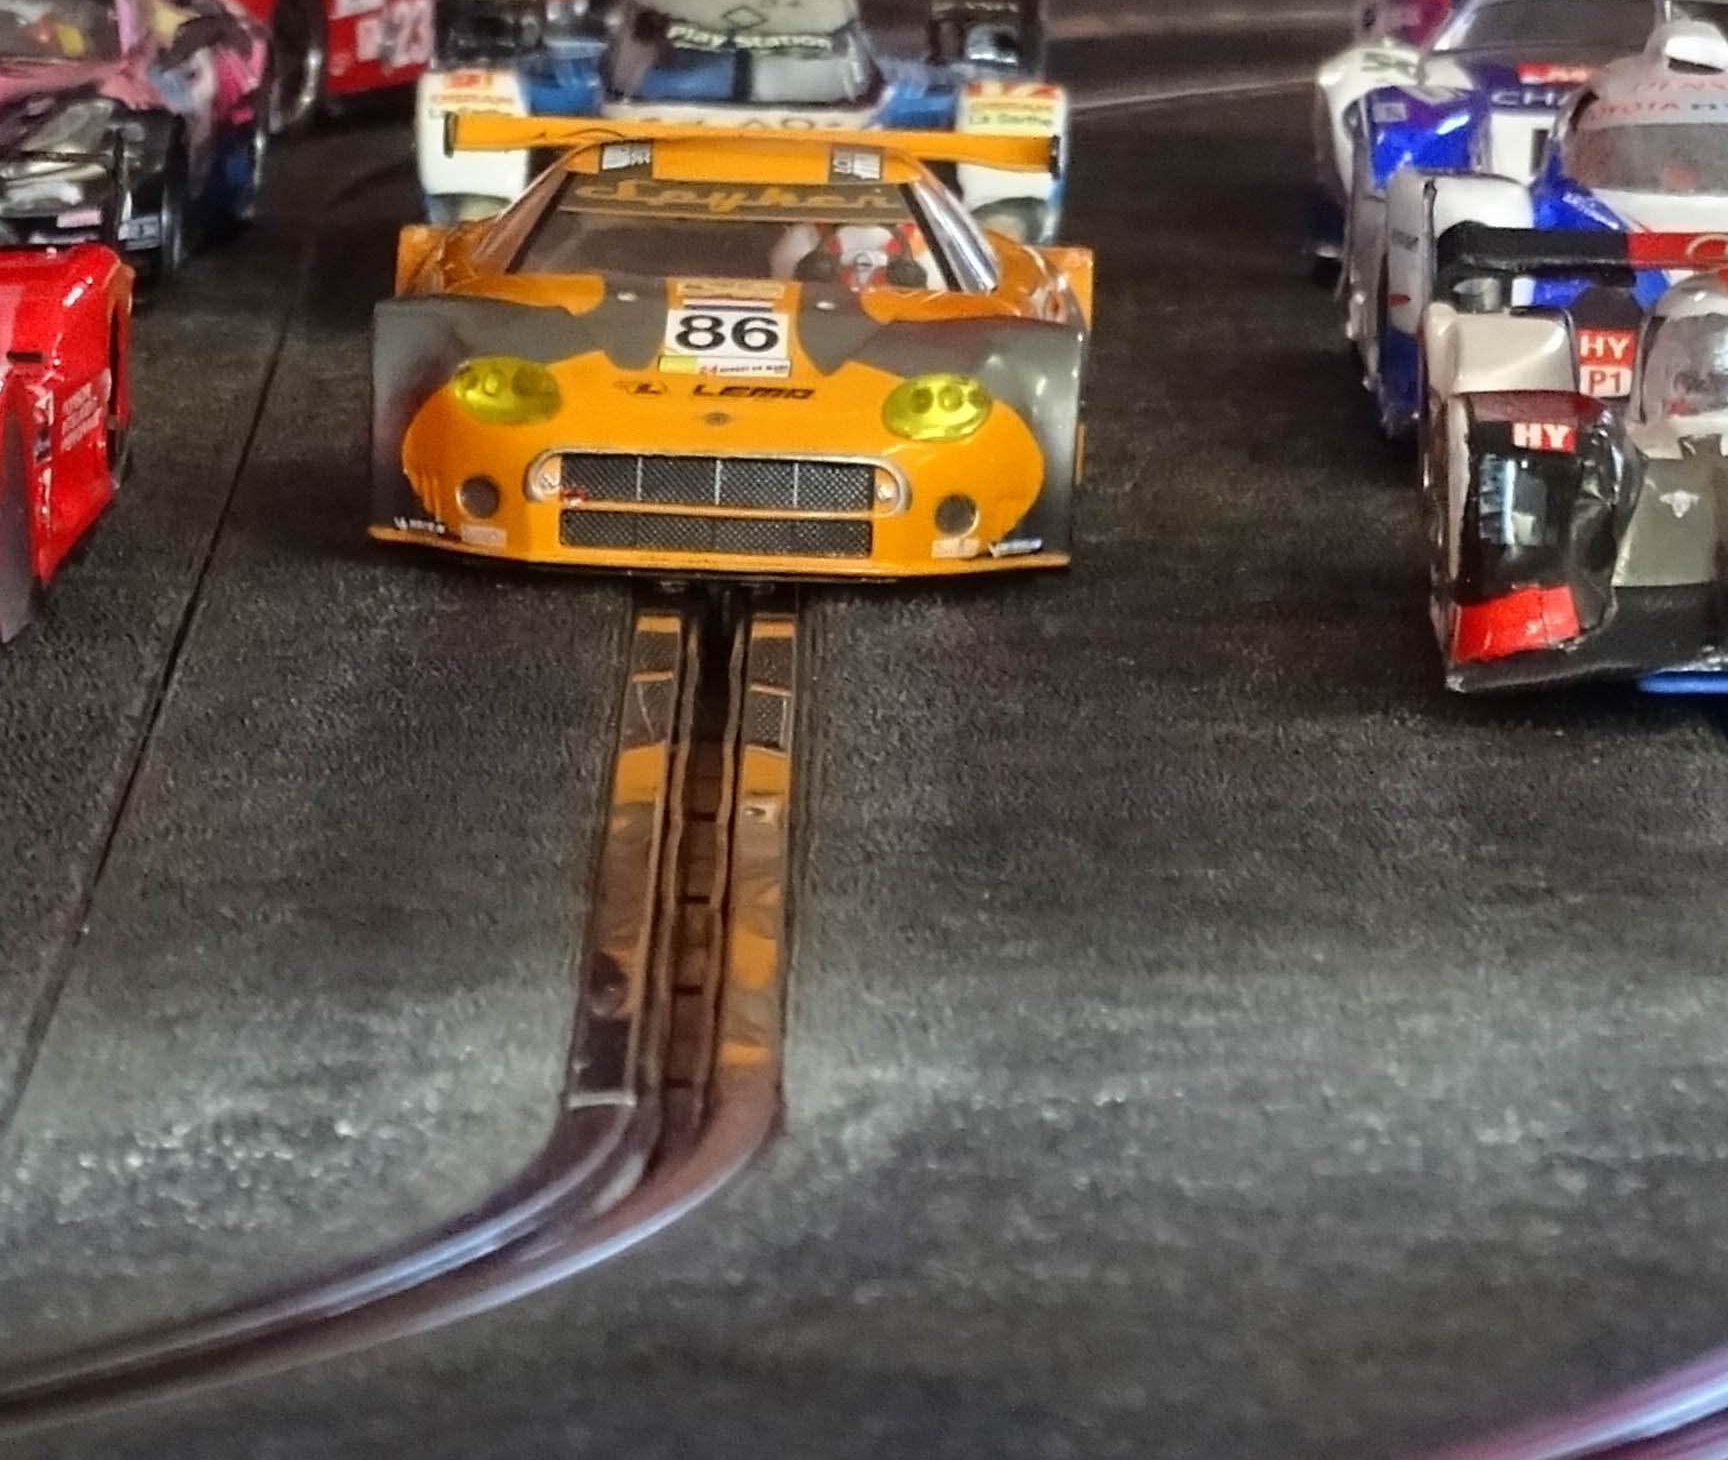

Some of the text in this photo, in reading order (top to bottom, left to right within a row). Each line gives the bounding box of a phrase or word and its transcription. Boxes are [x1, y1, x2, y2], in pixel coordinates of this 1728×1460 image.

[674, 315, 780, 353] 86
[1579, 335, 1629, 360] HY
[1589, 371, 1621, 394] P1
[1513, 423, 1570, 449] HY
